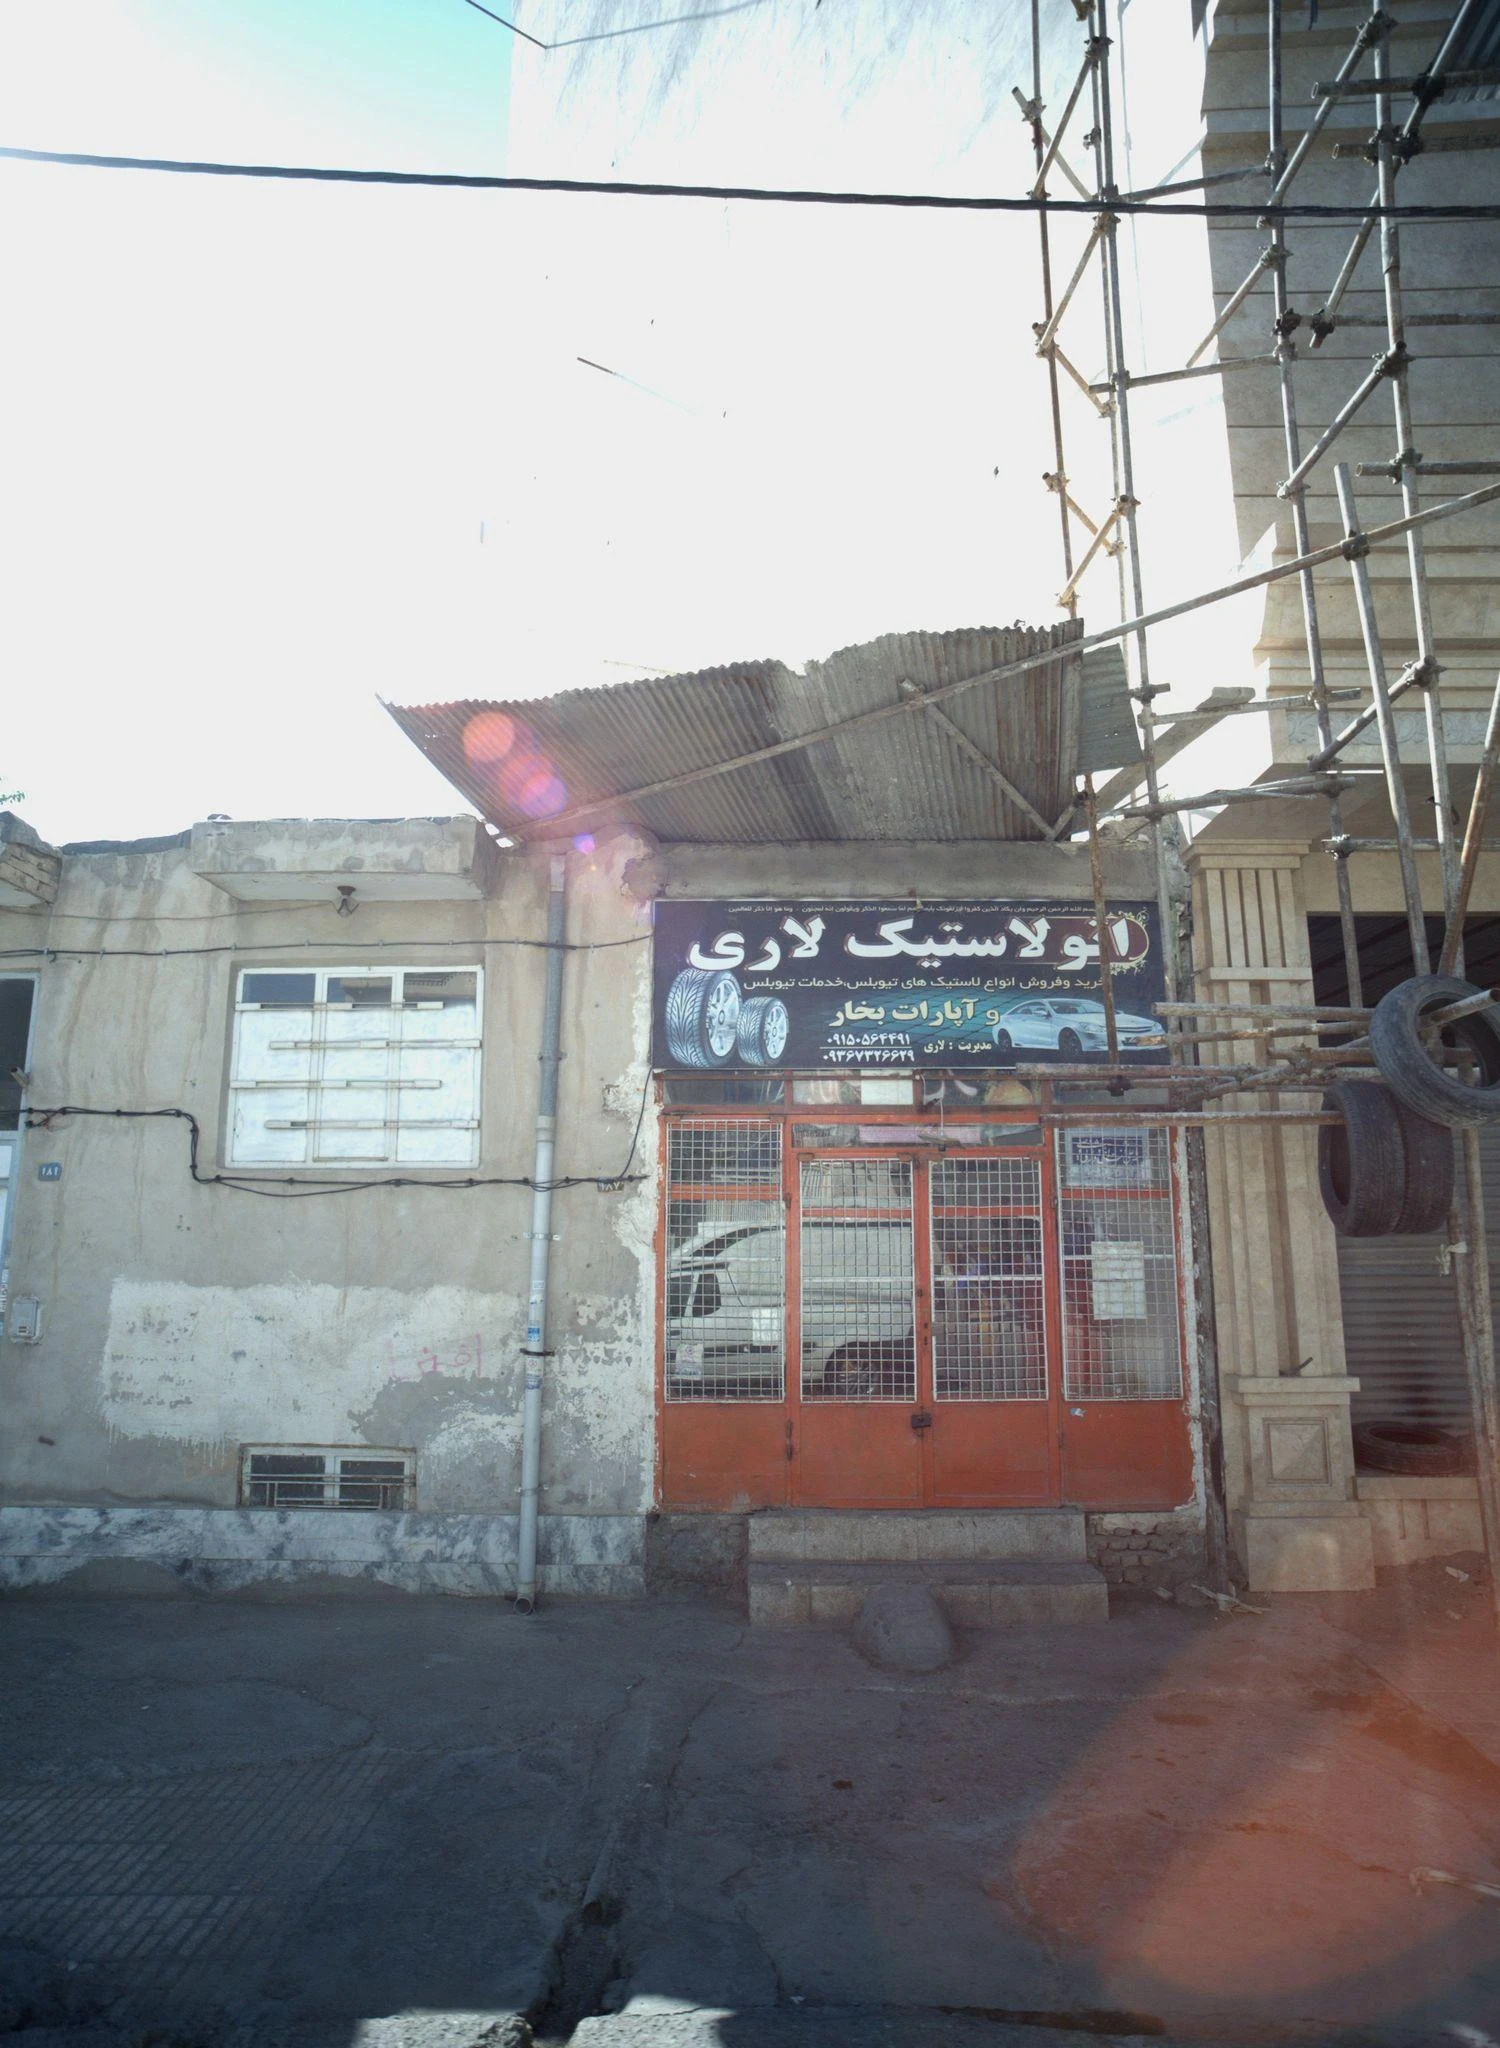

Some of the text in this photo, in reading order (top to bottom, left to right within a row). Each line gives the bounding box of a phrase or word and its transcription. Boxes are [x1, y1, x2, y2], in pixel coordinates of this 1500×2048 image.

[689, 916, 826, 971] لاری
[846, 917, 1051, 968] لاستیک
[743, 976, 796, 990] تیوبلس
[900, 977, 927, 990] های
[930, 976, 980, 990] لاستیک
[983, 976, 1015, 992] انواع
[829, 998, 1000, 1027] و آپارات بخار
[826, 1033, 910, 1046] ۰۹۱۵۰۵۶۴۴۹۱
[923, 1039, 945, 1054] لاری
[958, 1041, 992, 1054] مدیریت
